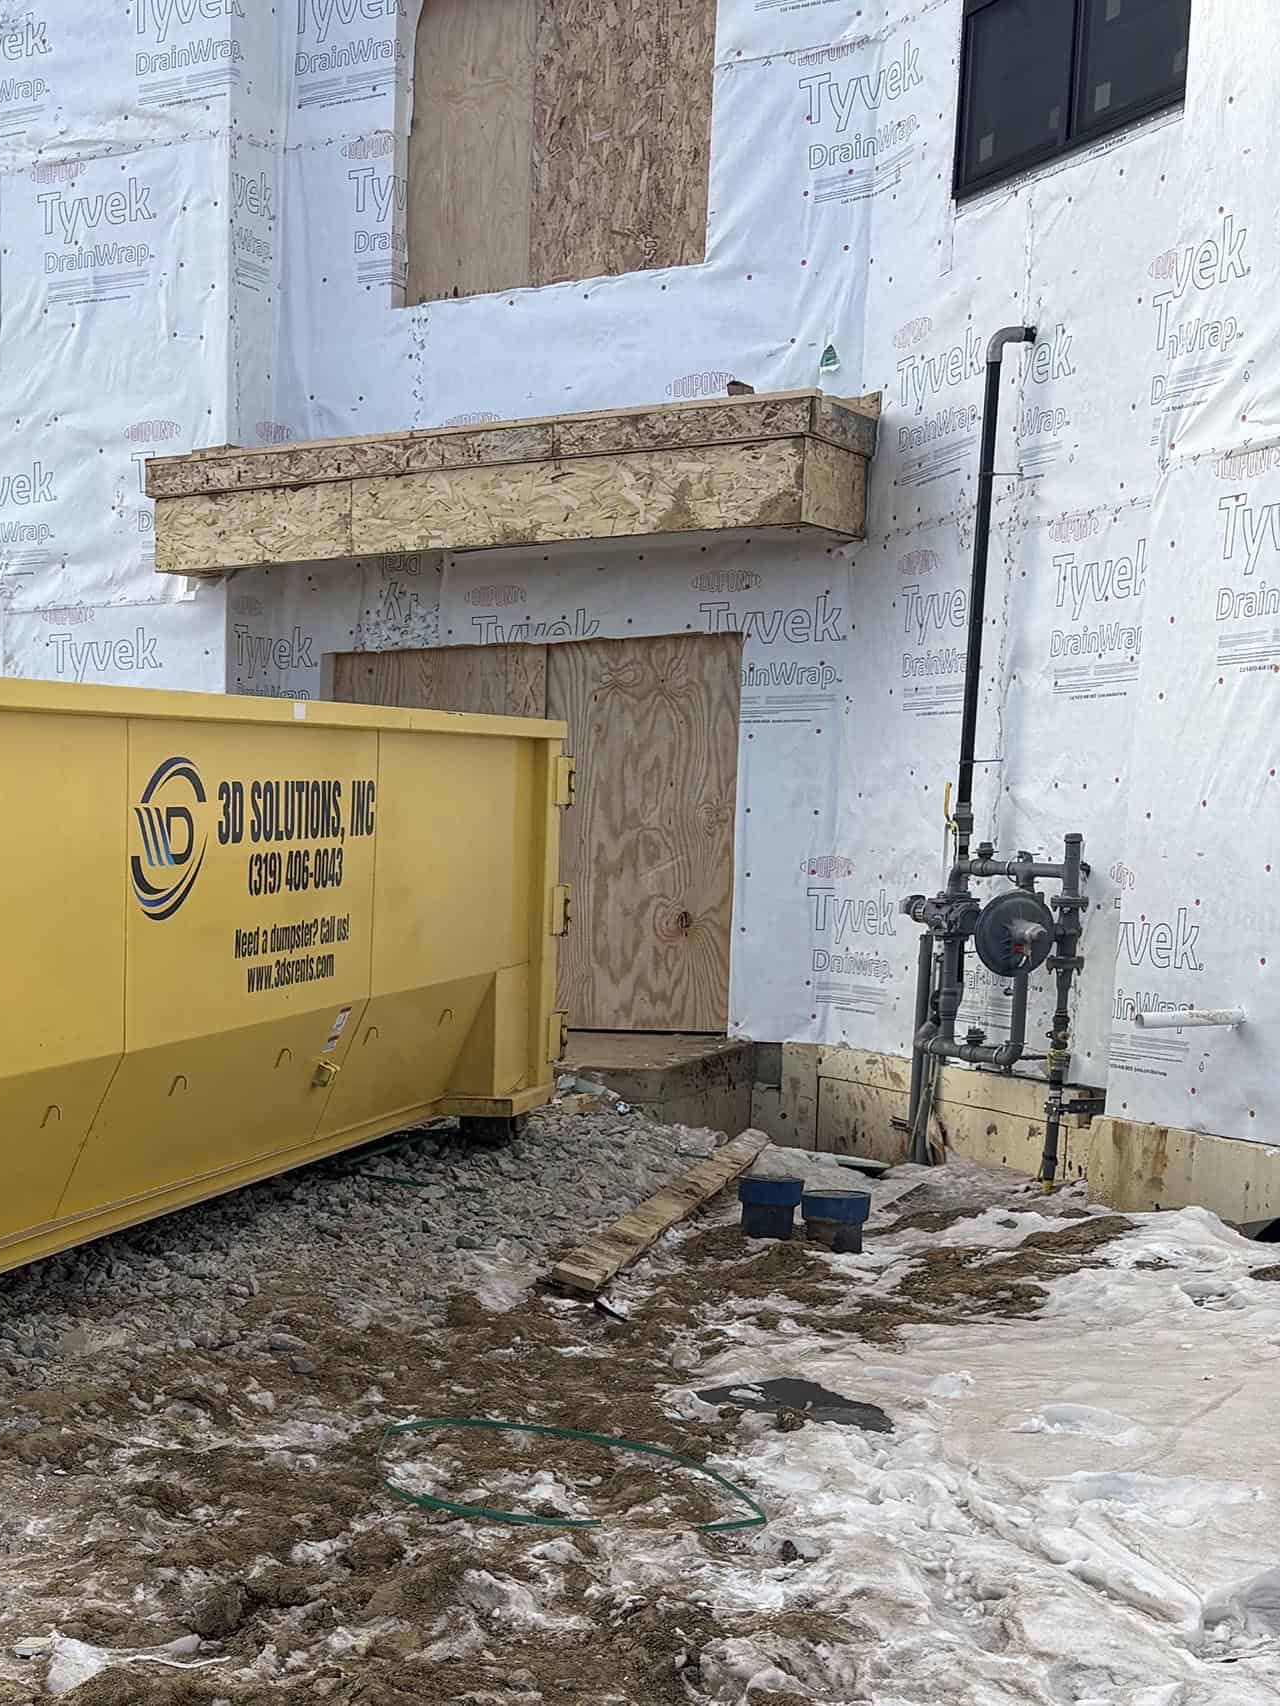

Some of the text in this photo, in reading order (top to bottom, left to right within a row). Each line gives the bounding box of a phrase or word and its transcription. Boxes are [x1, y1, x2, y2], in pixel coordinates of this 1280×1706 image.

[799, 40, 920, 132] Tyvek
[37, 177, 155, 245] Tyvek
[897, 328, 982, 415] Tyvek
[700, 597, 841, 644] Tyvek
[49, 627, 160, 682] Tyvek
[233, 625, 313, 680] Tyvek
[218, 780, 376, 844] 3D SOLUTIONS, INC
[248, 848, 344, 896] (319) 406-0043
[234, 913, 350, 959] Need a dumpster? Call us!
[807, 888, 896, 944] Tyvek
[247, 954, 335, 993] www.3dsrents.com
